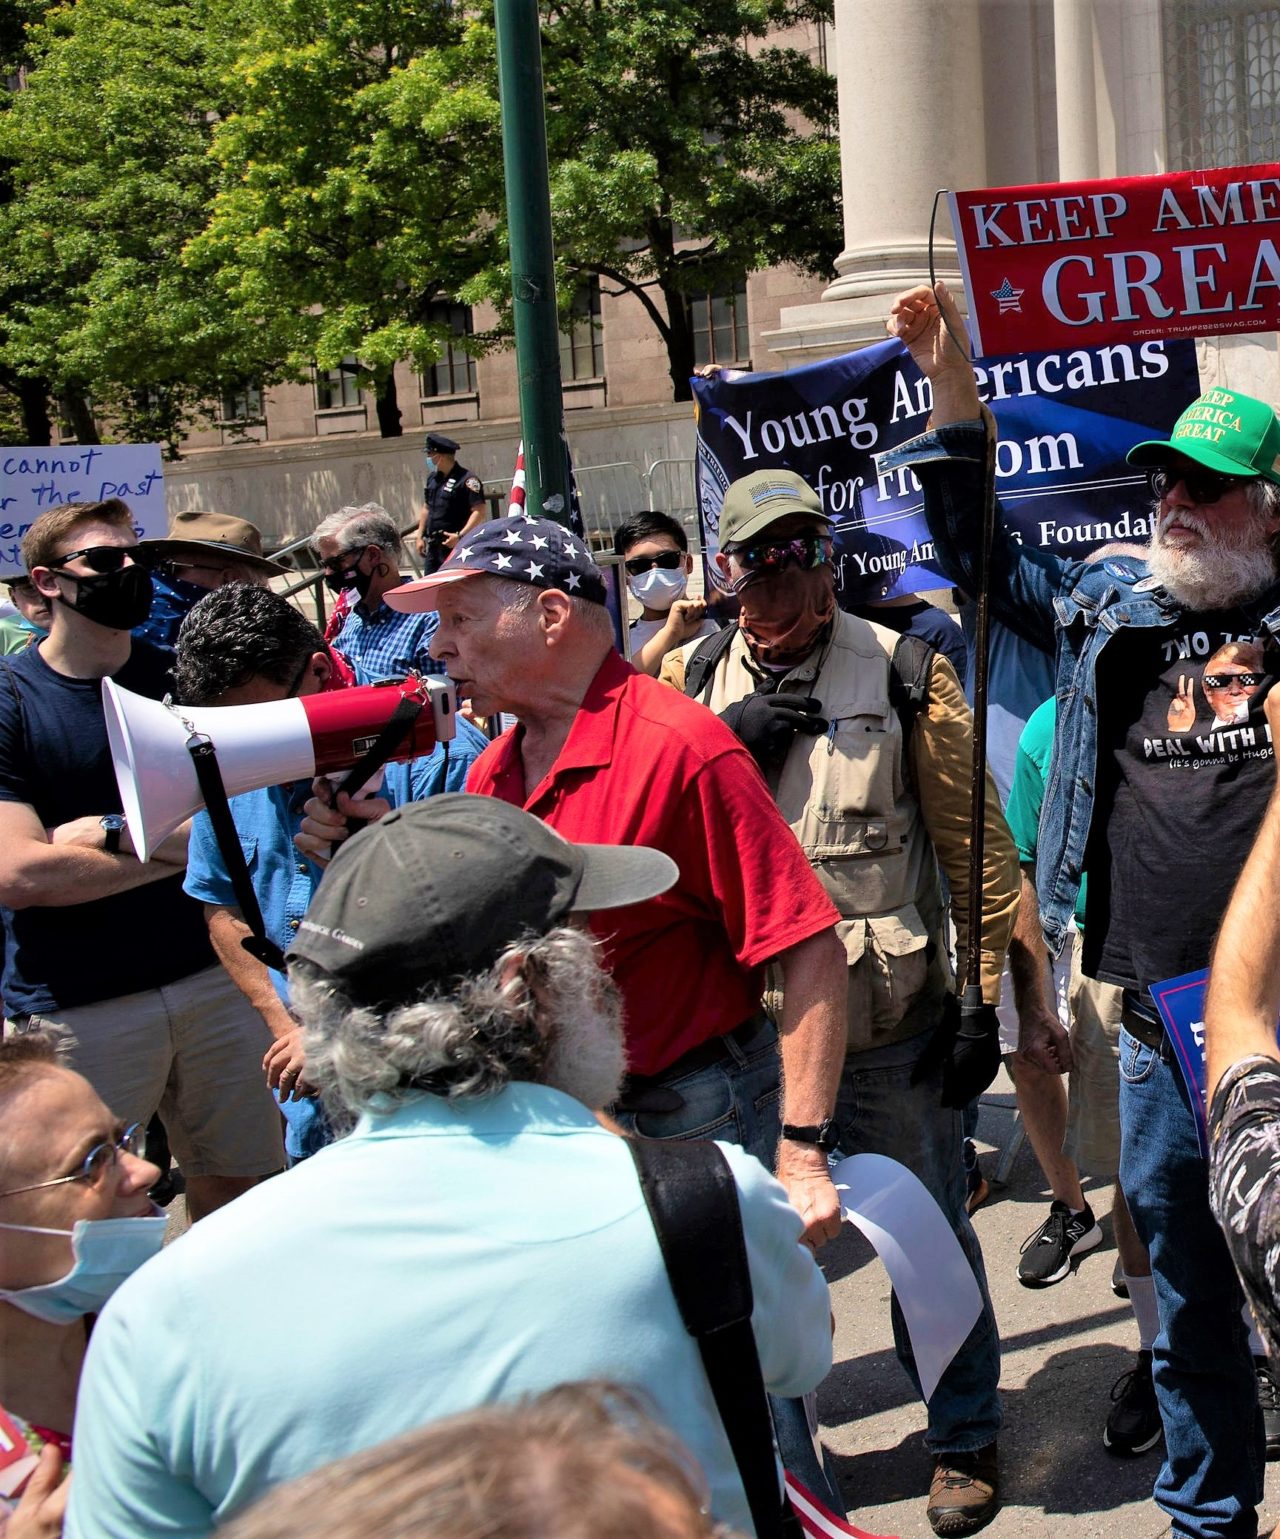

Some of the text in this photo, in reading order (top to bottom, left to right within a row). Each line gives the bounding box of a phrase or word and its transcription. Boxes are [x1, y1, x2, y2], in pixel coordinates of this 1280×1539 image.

[968, 193, 1127, 250] KEEP
[1168, 319, 1266, 333] TRUMP2020SWAG.COM
[724, 396, 878, 460] Young
[1176, 422, 1226, 444] GREAT
[3, 448, 102, 476] cannot
[707, 453, 728, 490] FREEDO
[100, 469, 163, 501] past
[852, 549, 908, 576] Young
[1161, 631, 1210, 661] TWO
[1143, 738, 1191, 758] DEAL
[1196, 728, 1256, 758] WITH
[1192, 755, 1226, 770] gonna
[1228, 753, 1239, 762] be
